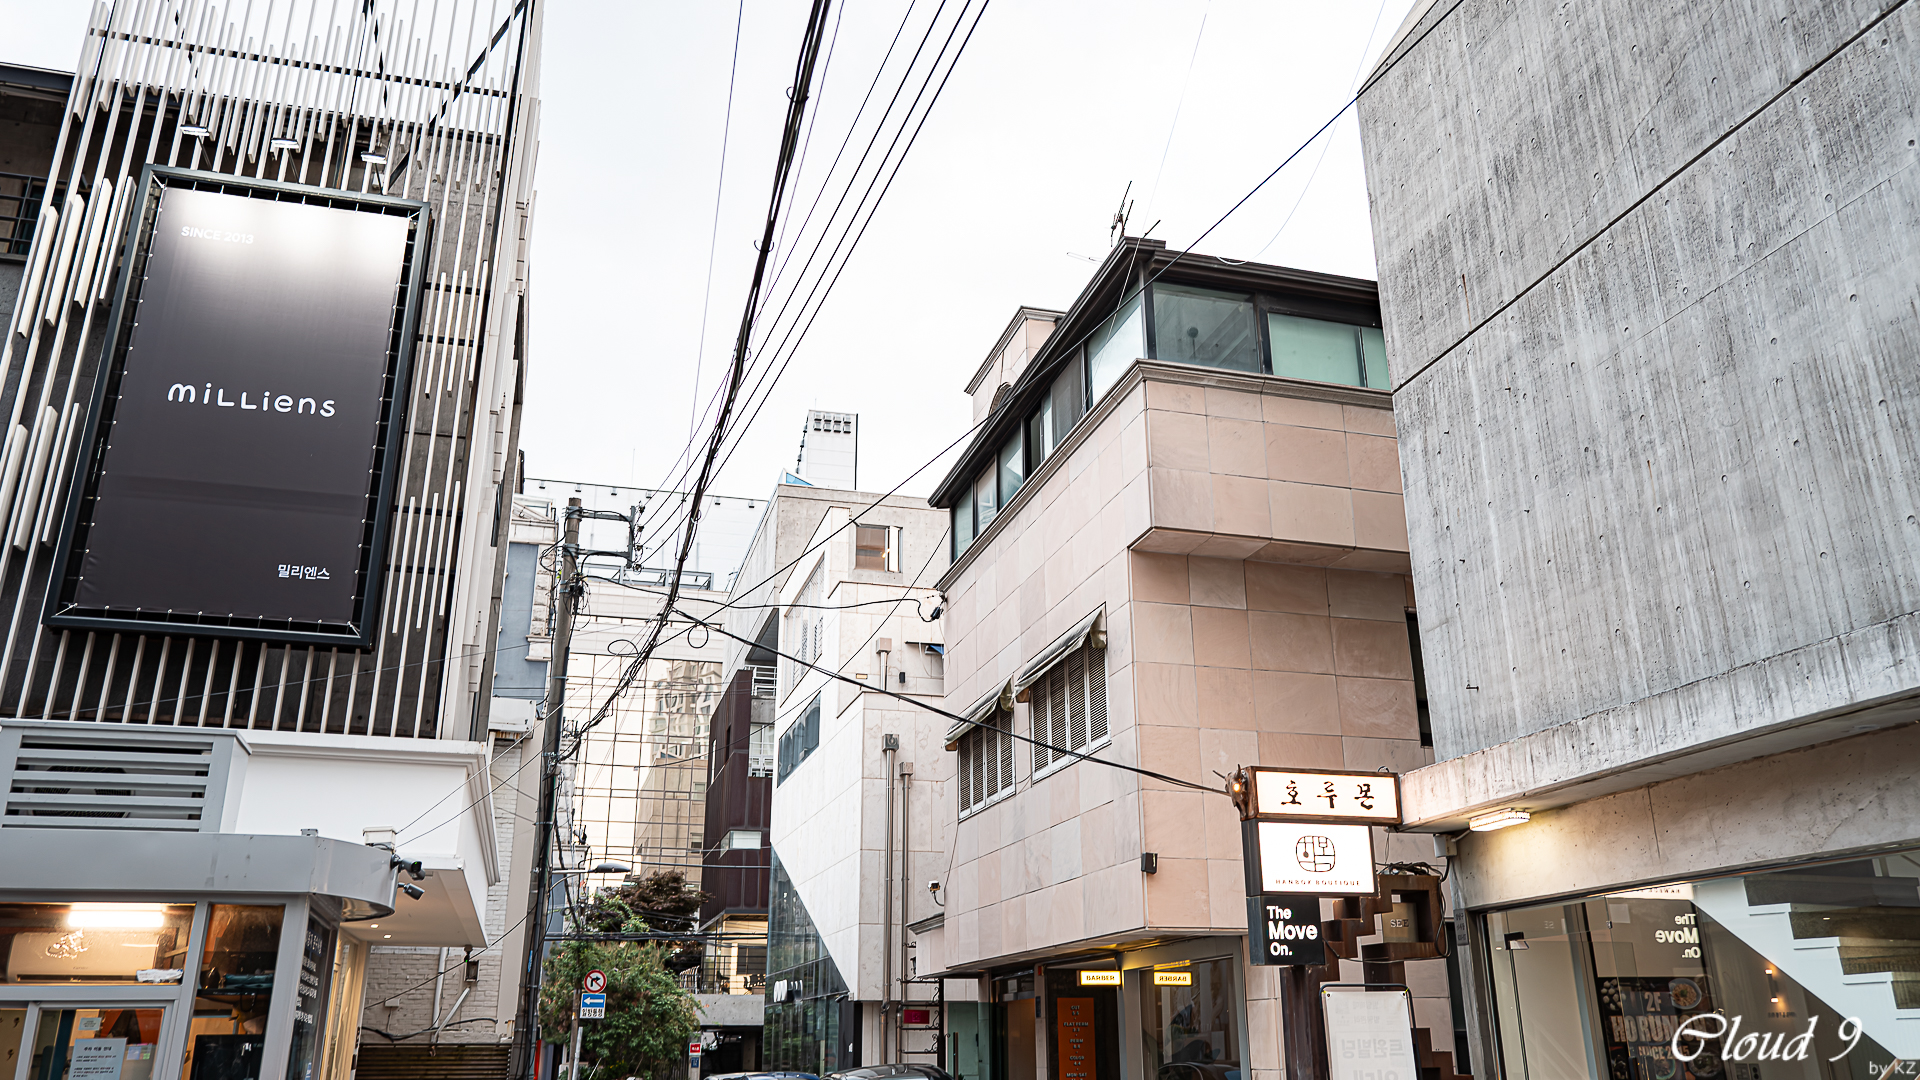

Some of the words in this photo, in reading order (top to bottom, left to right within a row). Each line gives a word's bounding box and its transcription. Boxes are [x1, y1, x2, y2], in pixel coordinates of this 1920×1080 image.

[181, 226, 222, 240] SINCE
[224, 231, 254, 244] 2013
[278, 564, 330, 580] 밀리엔스
[1266, 905, 1293, 920] The
[1267, 920, 1318, 941] Move
[1390, 918, 1409, 928] SEE
[1270, 941, 1293, 956] On.
[1644, 991, 1662, 1012] 2F
[1665, 1045, 1690, 1060] 215
